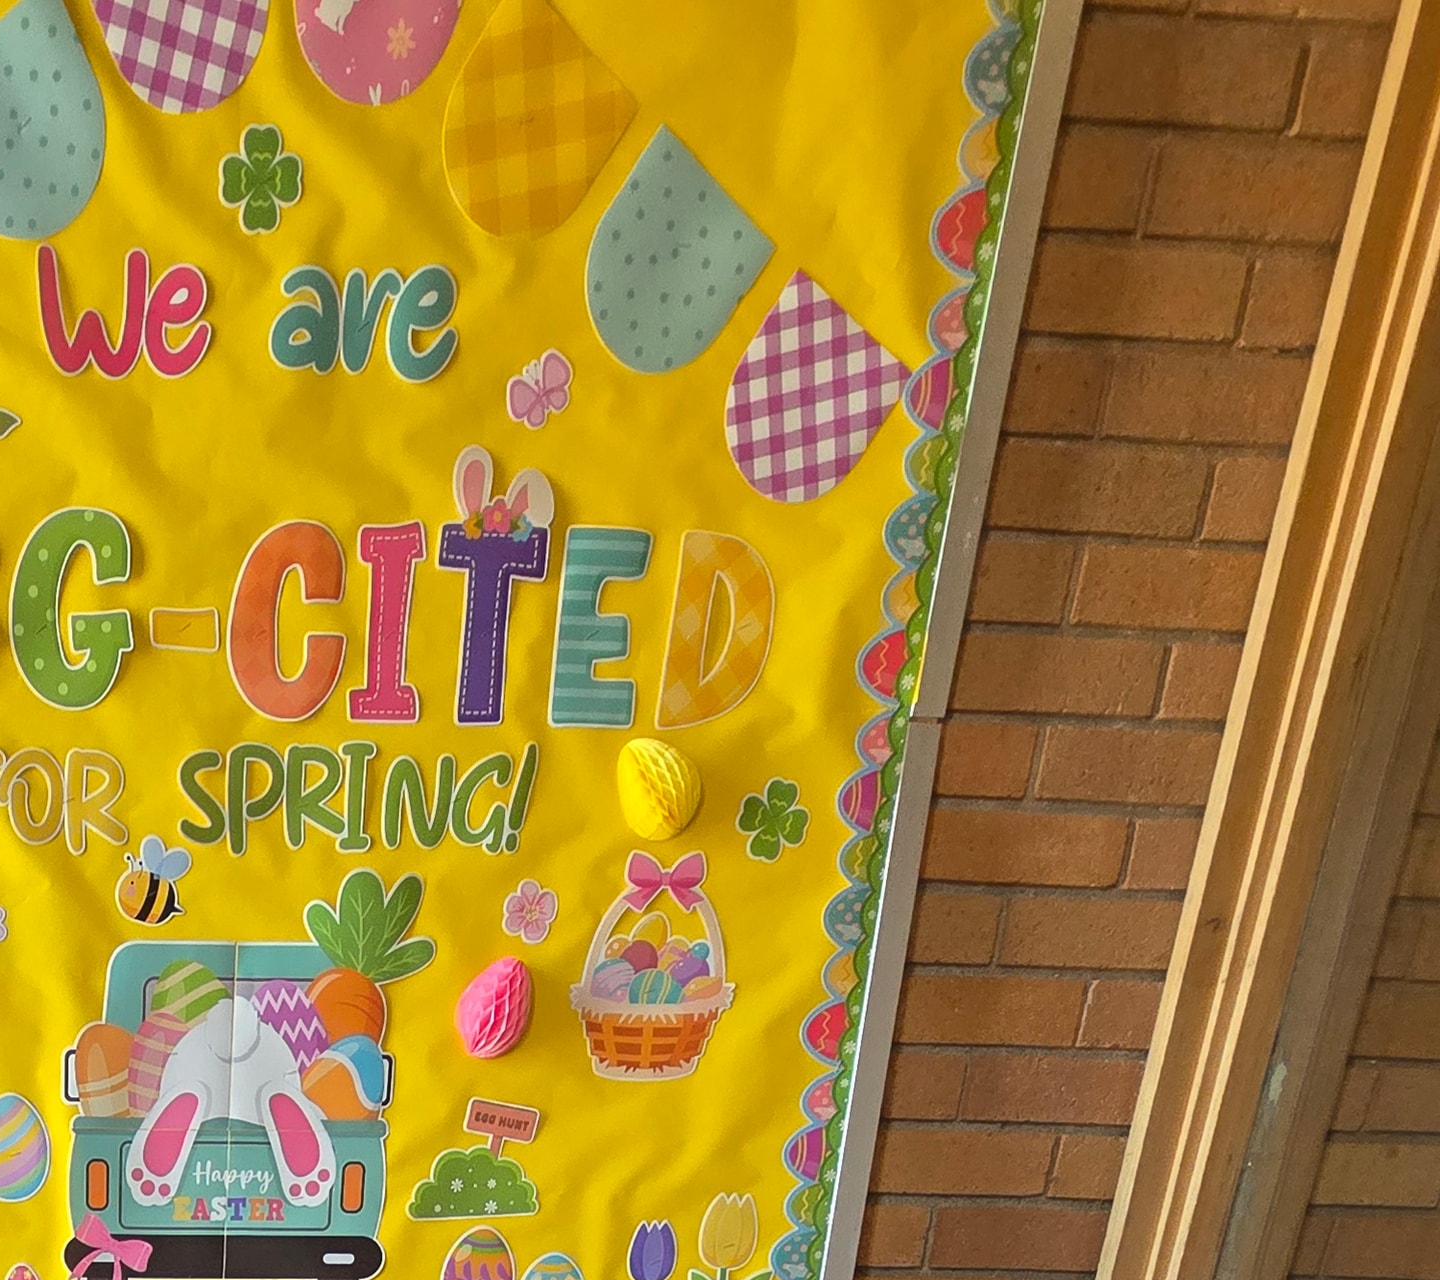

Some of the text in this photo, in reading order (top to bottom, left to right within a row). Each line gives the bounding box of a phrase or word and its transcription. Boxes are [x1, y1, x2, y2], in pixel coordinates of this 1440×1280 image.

[36, 243, 458, 383] We are
[177, 740, 539, 856] SPRING!
[474, 1111, 529, 1132] EGG HUNT
[192, 1160, 274, 1194] Happy
[172, 1197, 285, 1222] EASTER
